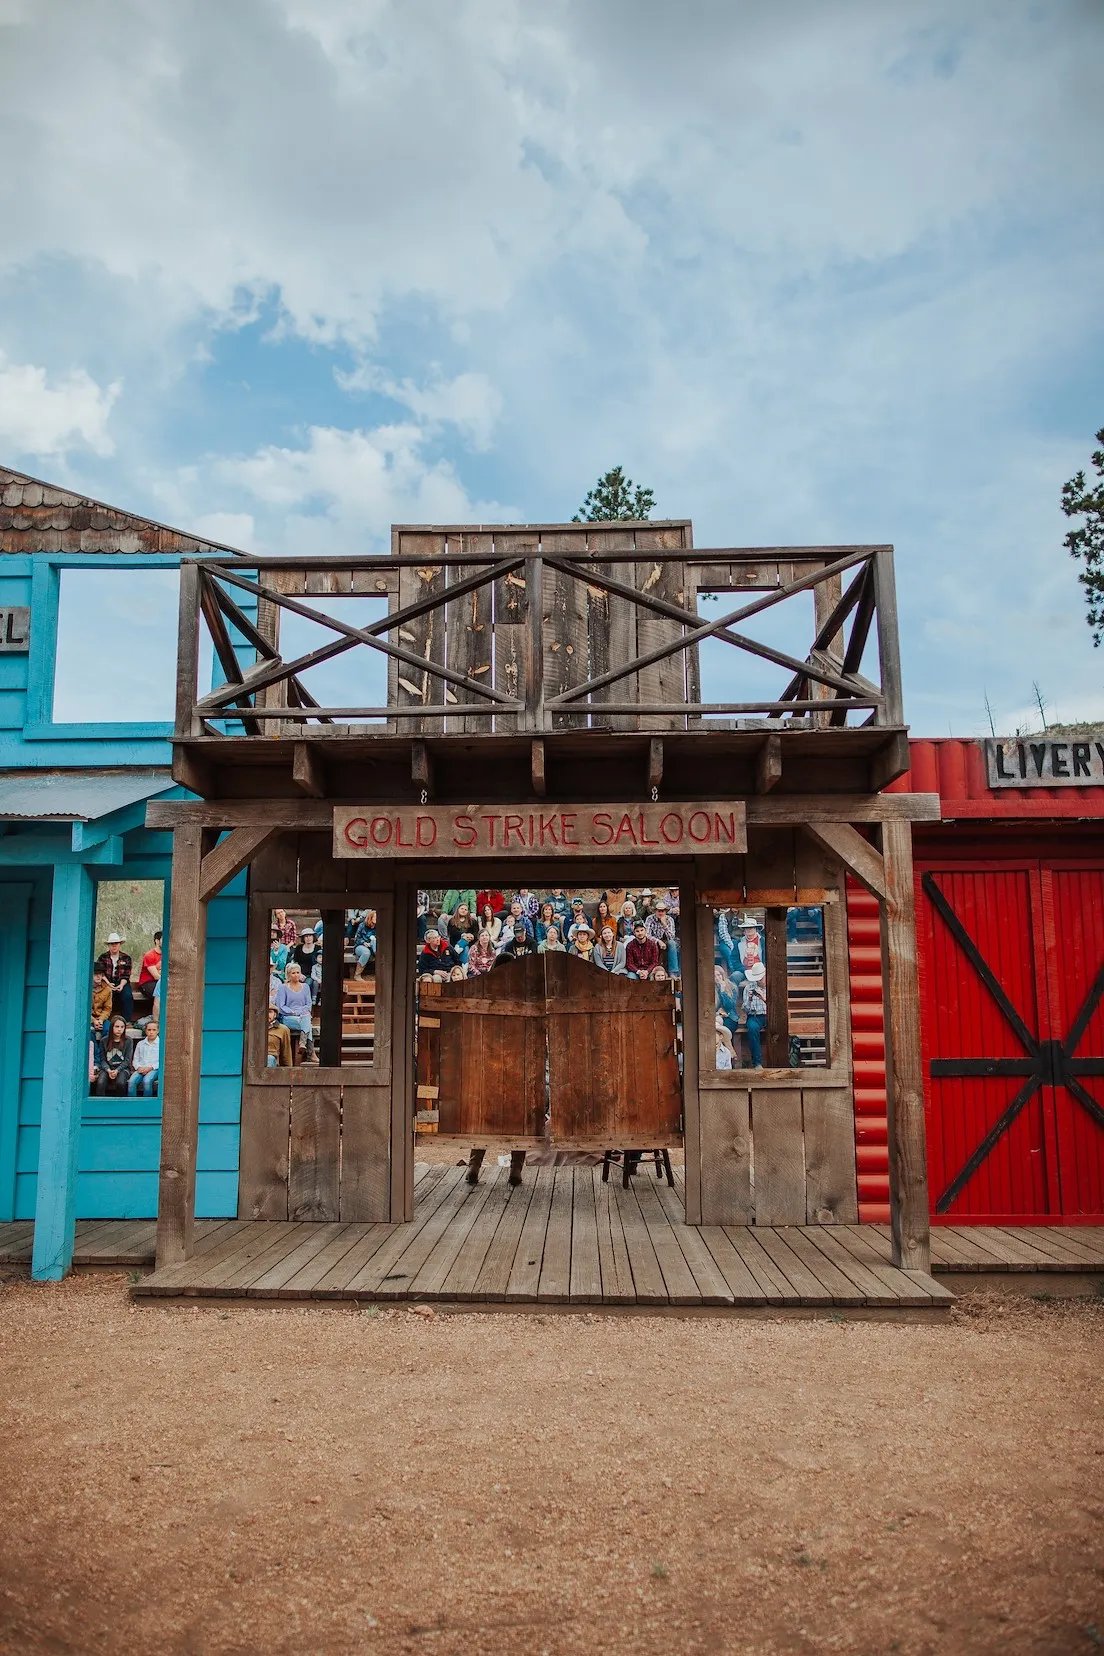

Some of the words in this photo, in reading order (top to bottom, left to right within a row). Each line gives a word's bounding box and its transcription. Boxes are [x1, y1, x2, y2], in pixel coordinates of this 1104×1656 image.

[0, 613, 23, 643] L
[344, 816, 437, 848] GOLD
[453, 813, 579, 848] STRIKE
[591, 811, 735, 846] SALOON
